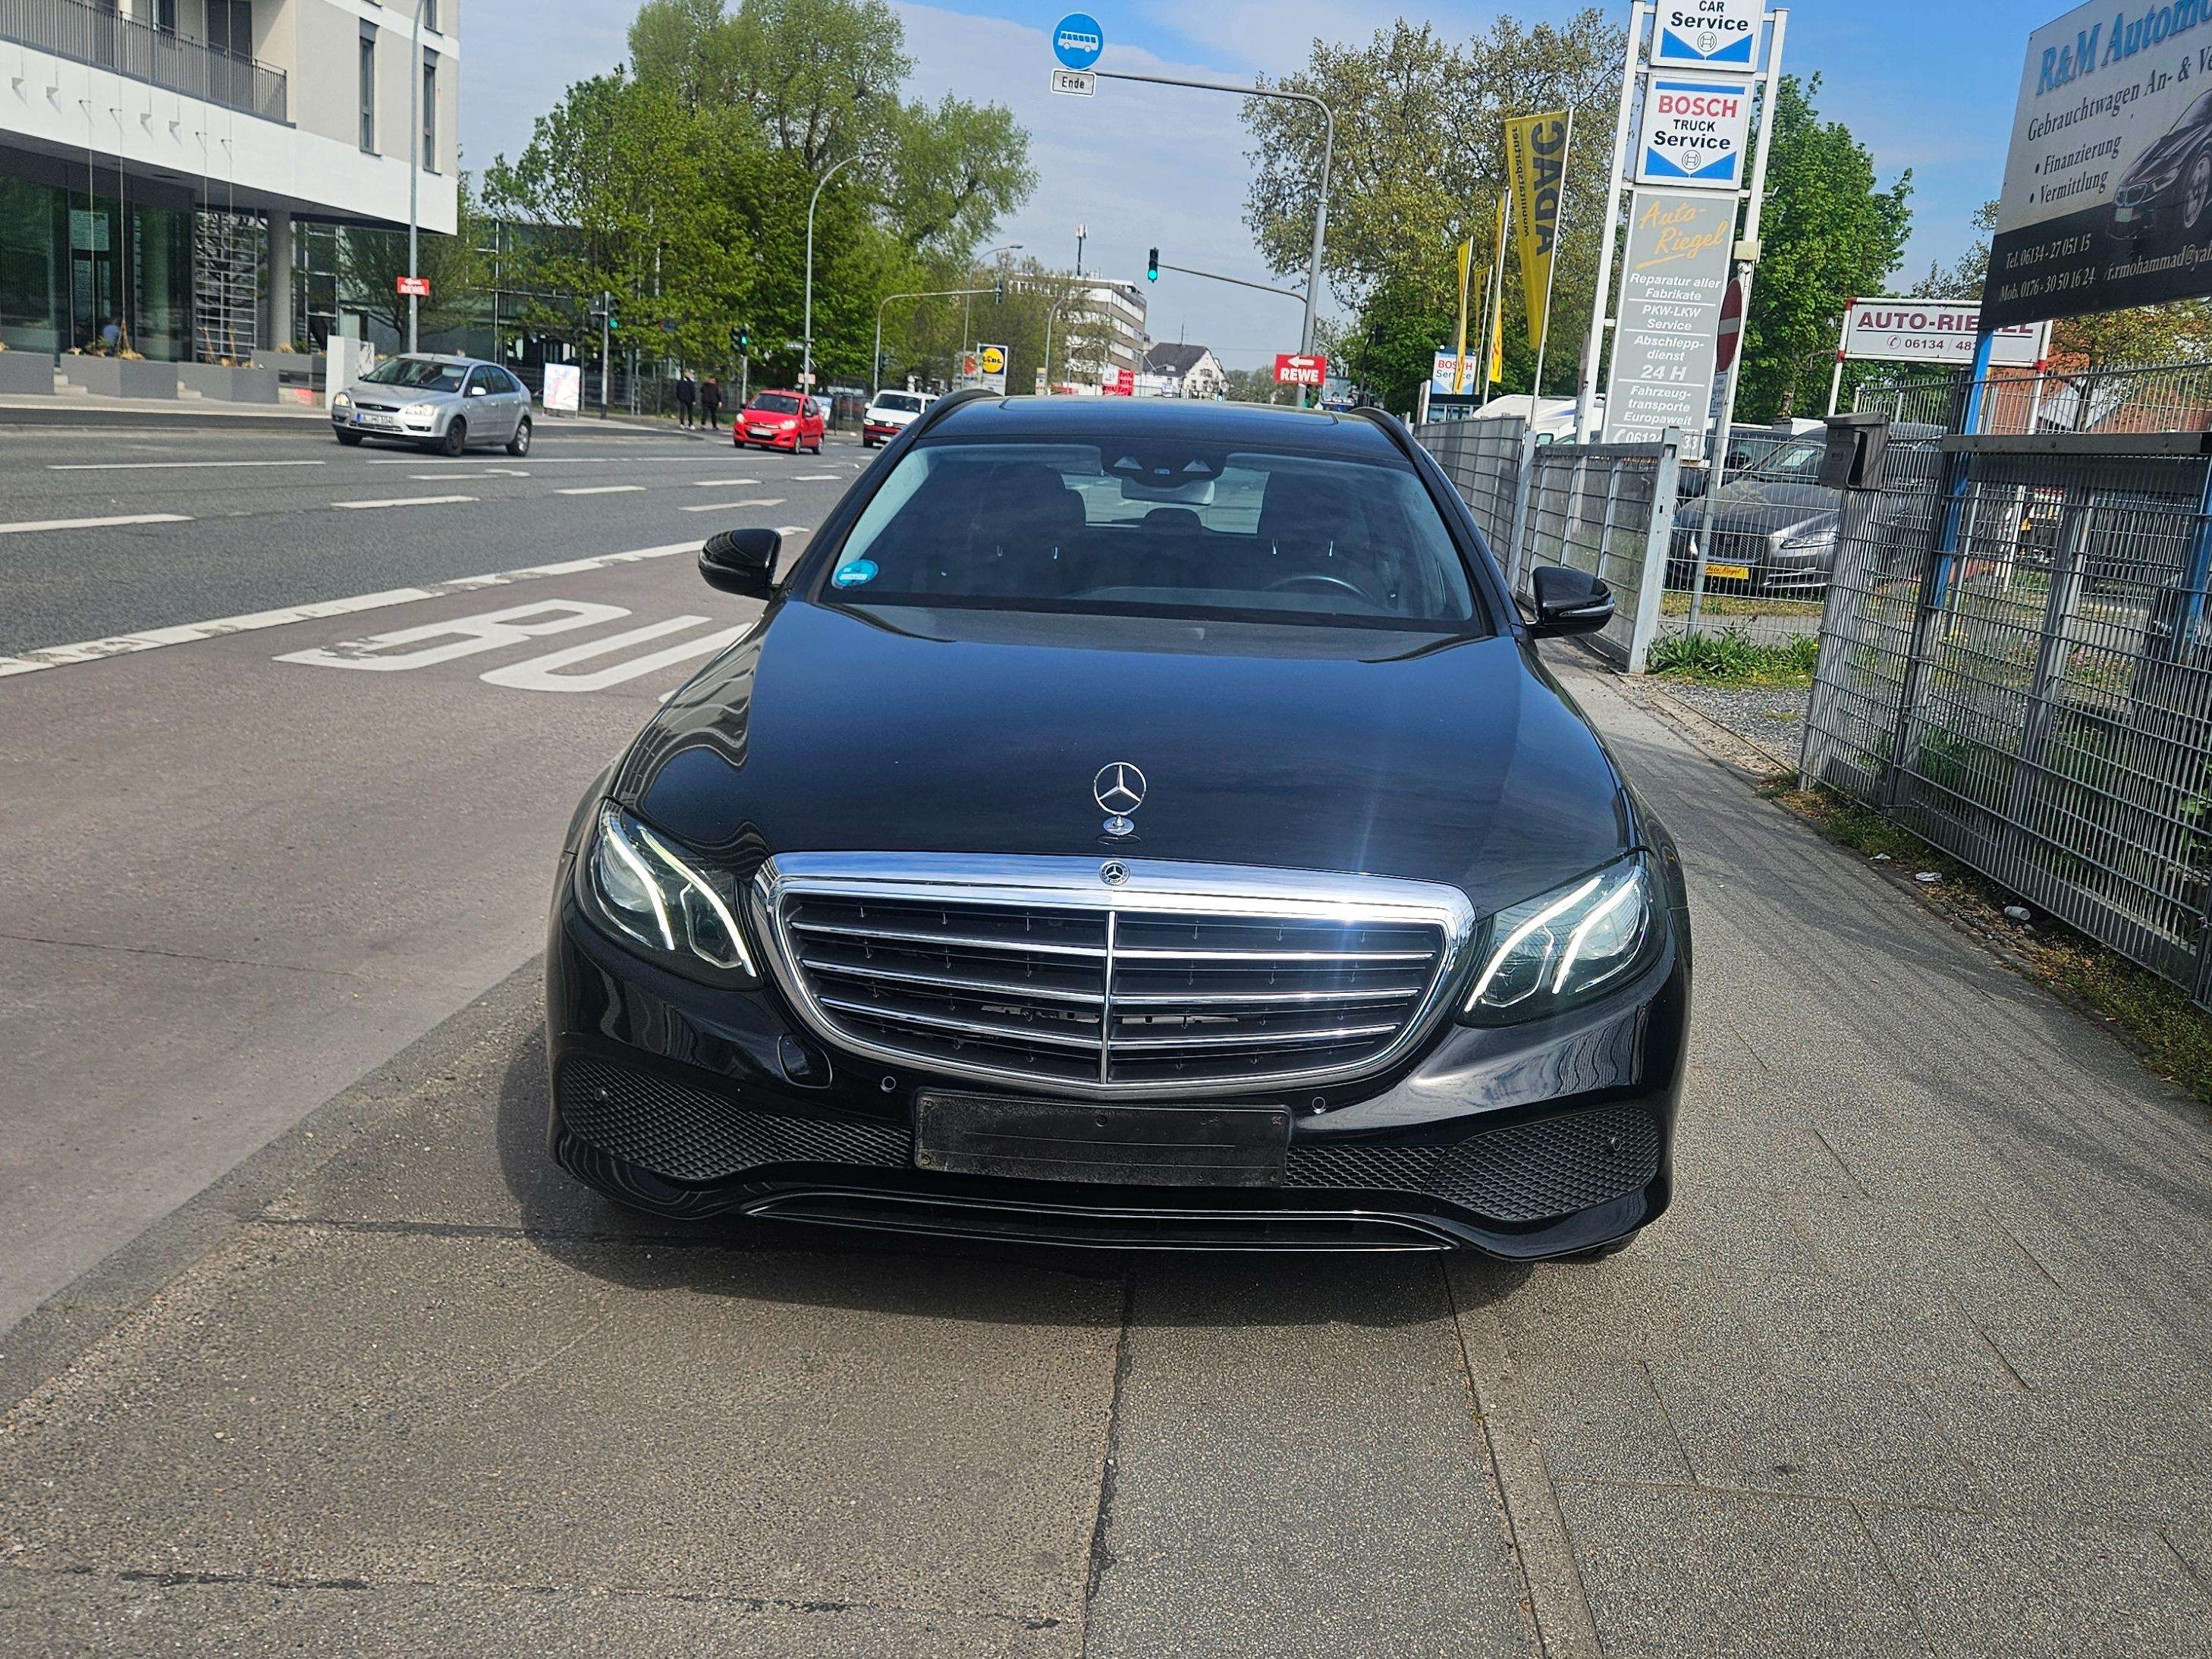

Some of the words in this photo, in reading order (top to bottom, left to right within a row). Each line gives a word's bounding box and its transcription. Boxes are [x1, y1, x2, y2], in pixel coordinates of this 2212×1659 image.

[1698, 1, 1725, 13] CAR
[1670, 11, 1749, 31] Service
[2035, 23, 2102, 96] R&M
[1062, 77, 1085, 89] Ende
[2028, 83, 2141, 141] Gebrauchtwagen
[2143, 69, 2173, 97] An-
[2178, 55, 2192, 83] &
[1658, 95, 1738, 118] BOSCH
[1673, 118, 1716, 133] TRUCK
[1654, 130, 1731, 150] Service
[2044, 136, 2122, 175] Finanzierung
[2041, 171, 2109, 204] Vermittlung
[1639, 200, 1707, 230] Auto-
[1654, 219, 1729, 259] Riegel
[2006, 251, 2019, 269] Tel.
[2020, 244, 2044, 266] 06134
[2049, 240, 2062, 259] 27
[2080, 233, 2091, 252] 15
[1630, 273, 1691, 287] Reparatur
[1693, 277, 1721, 289] aller
[1999, 283, 2019, 302] Mob.
[2020, 278, 2041, 297] 0176
[2044, 275, 2056, 293] 30
[2057, 272, 2069, 291] 50
[2070, 269, 2082, 288] 16
[1645, 288, 1701, 300] Fabrikate
[1642, 305, 1701, 317] PKW-LKW
[1647, 319, 1692, 331] Service
[1858, 312, 2034, 334] AUTO-RIEL
[1634, 335, 1704, 350] Abschlepp-
[1905, 339, 1943, 350] 06134
[1956, 341, 1977, 350] 48
[1647, 350, 1686, 361] dienst
[1438, 360, 1472, 371] BOSH
[1640, 364, 1664, 379] 24
[1669, 366, 1686, 381] H
[1280, 367, 1319, 382] REWE
[1436, 369, 1472, 379] Sere
[1630, 385, 1692, 401] Fahrzeug-
[1628, 400, 1690, 413] transporte
[1623, 412, 1692, 426] Europaweit
[272, 599, 755, 704] BU
